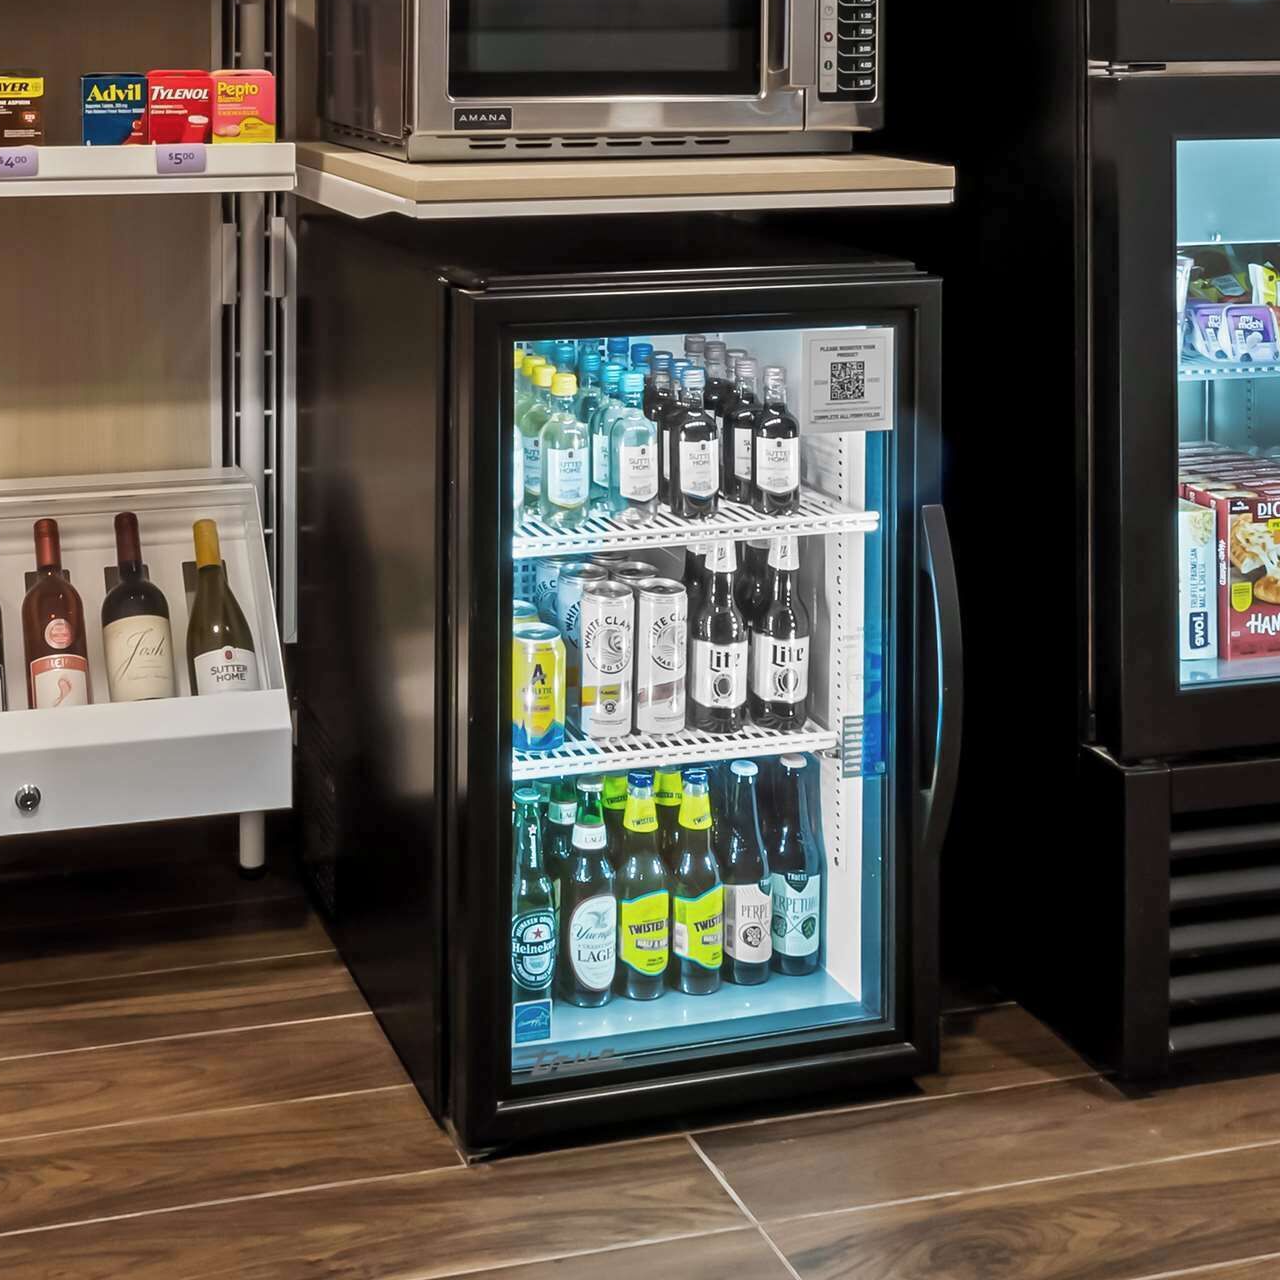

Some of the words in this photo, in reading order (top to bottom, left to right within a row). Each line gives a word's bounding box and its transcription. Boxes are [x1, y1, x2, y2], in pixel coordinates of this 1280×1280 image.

[87, 84, 141, 102] Advil
[151, 86, 209, 100] TYLENOL
[218, 82, 258, 97] Pepto
[1239, 322, 1264, 330] mochi
[1240, 315, 1253, 323] my
[584, 616, 602, 649] WHITE
[210, 665, 247, 675] SUTTER
[216, 672, 246, 682] HOME
[628, 920, 665, 935] TWISTED
